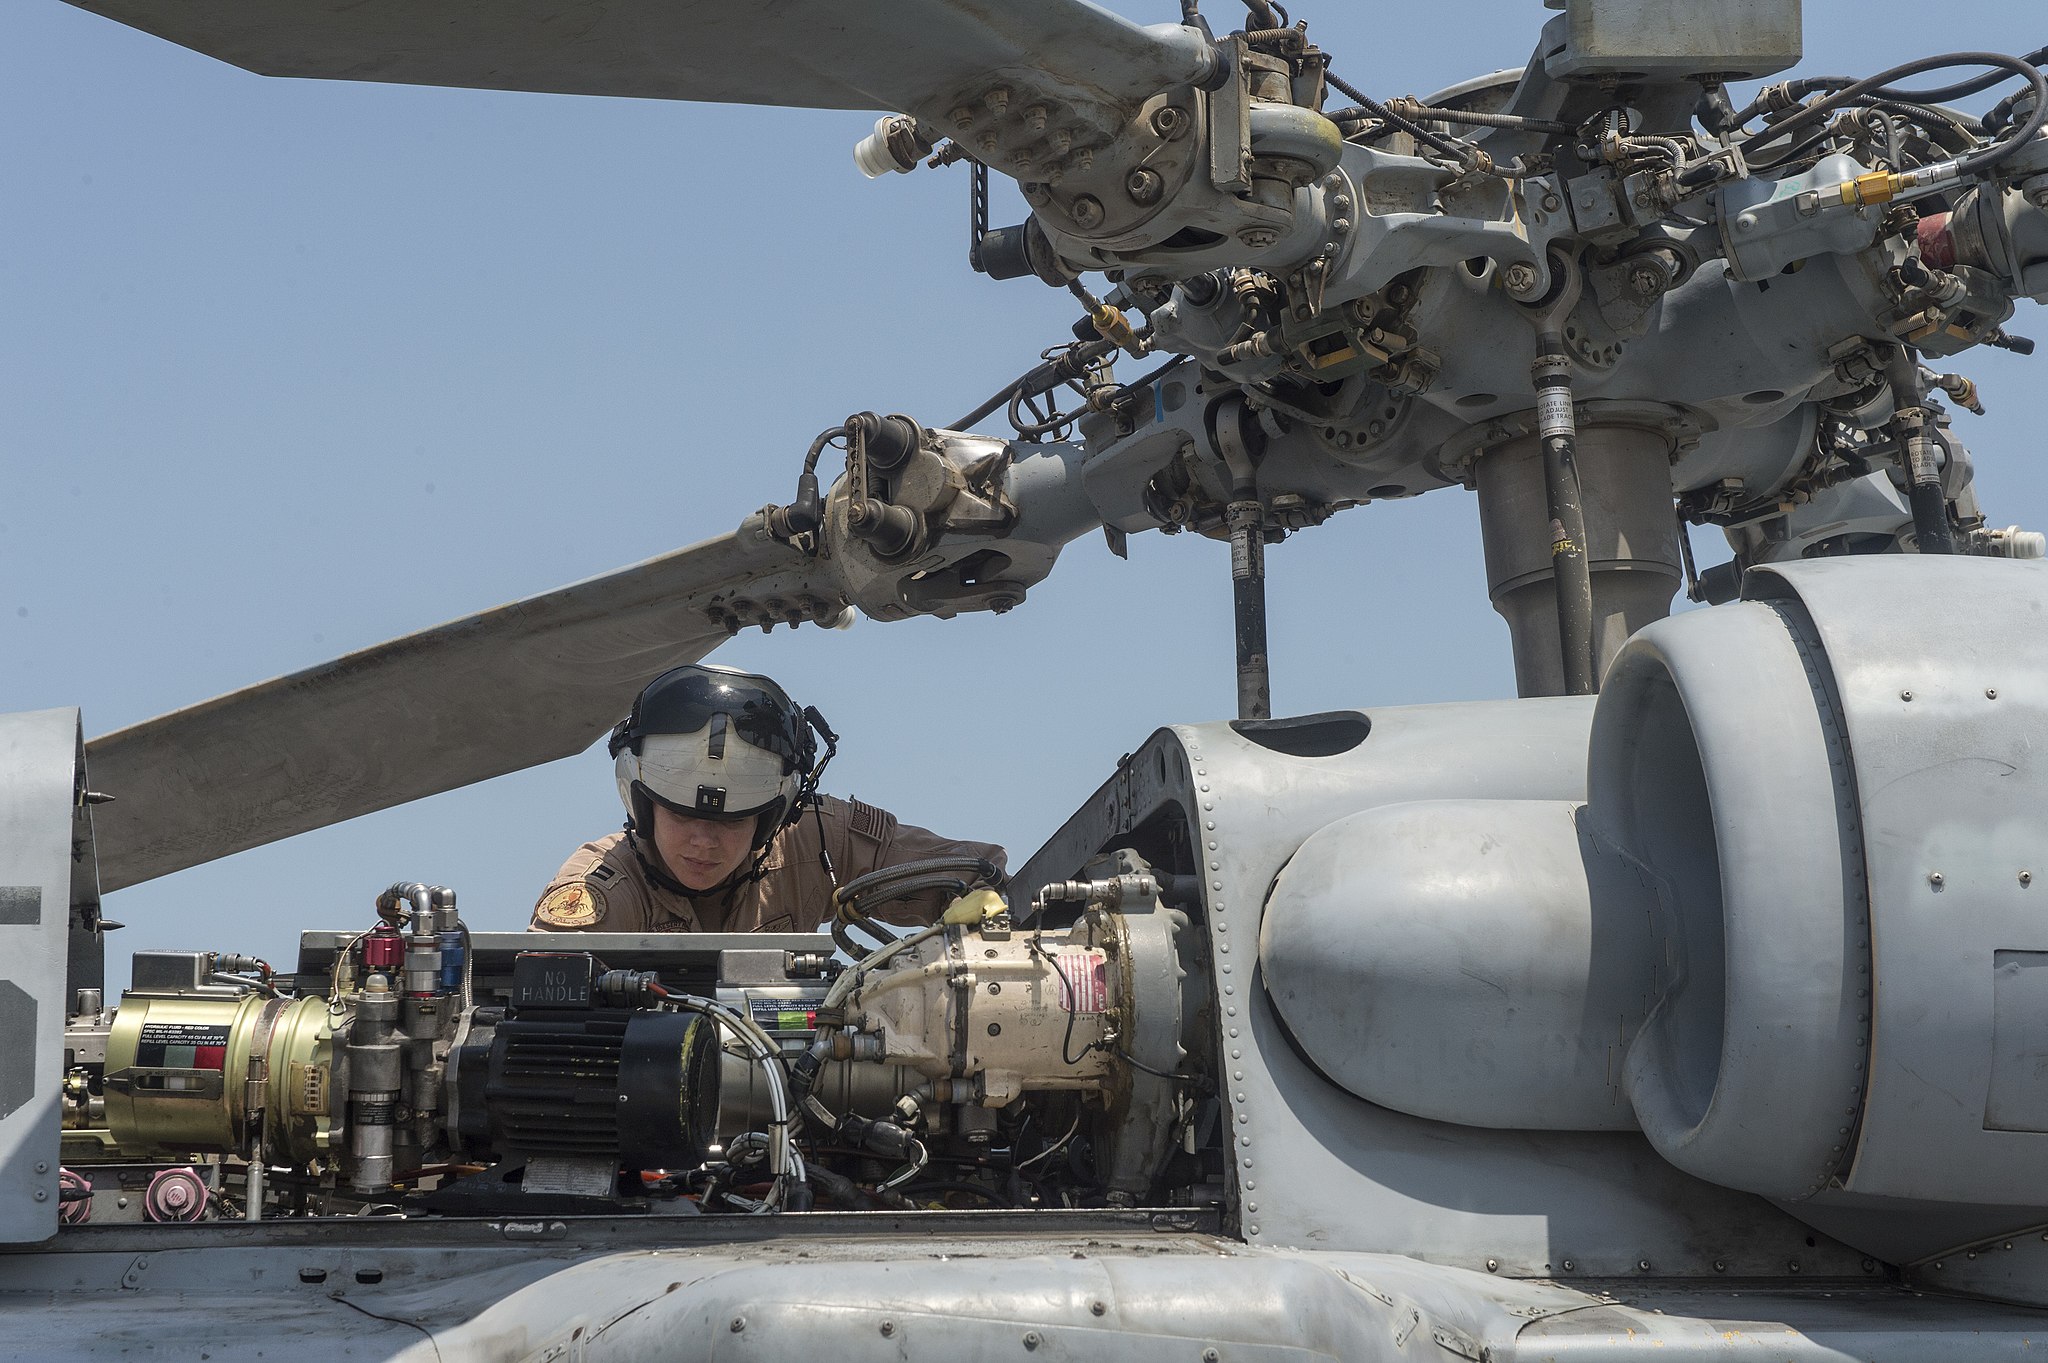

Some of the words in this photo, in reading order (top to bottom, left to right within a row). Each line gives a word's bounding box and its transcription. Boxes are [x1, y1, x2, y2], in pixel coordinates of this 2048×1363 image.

[1539, 400, 1557, 409] OTATE
[545, 971, 566, 985] NO
[522, 986, 587, 1001] HANDLE
